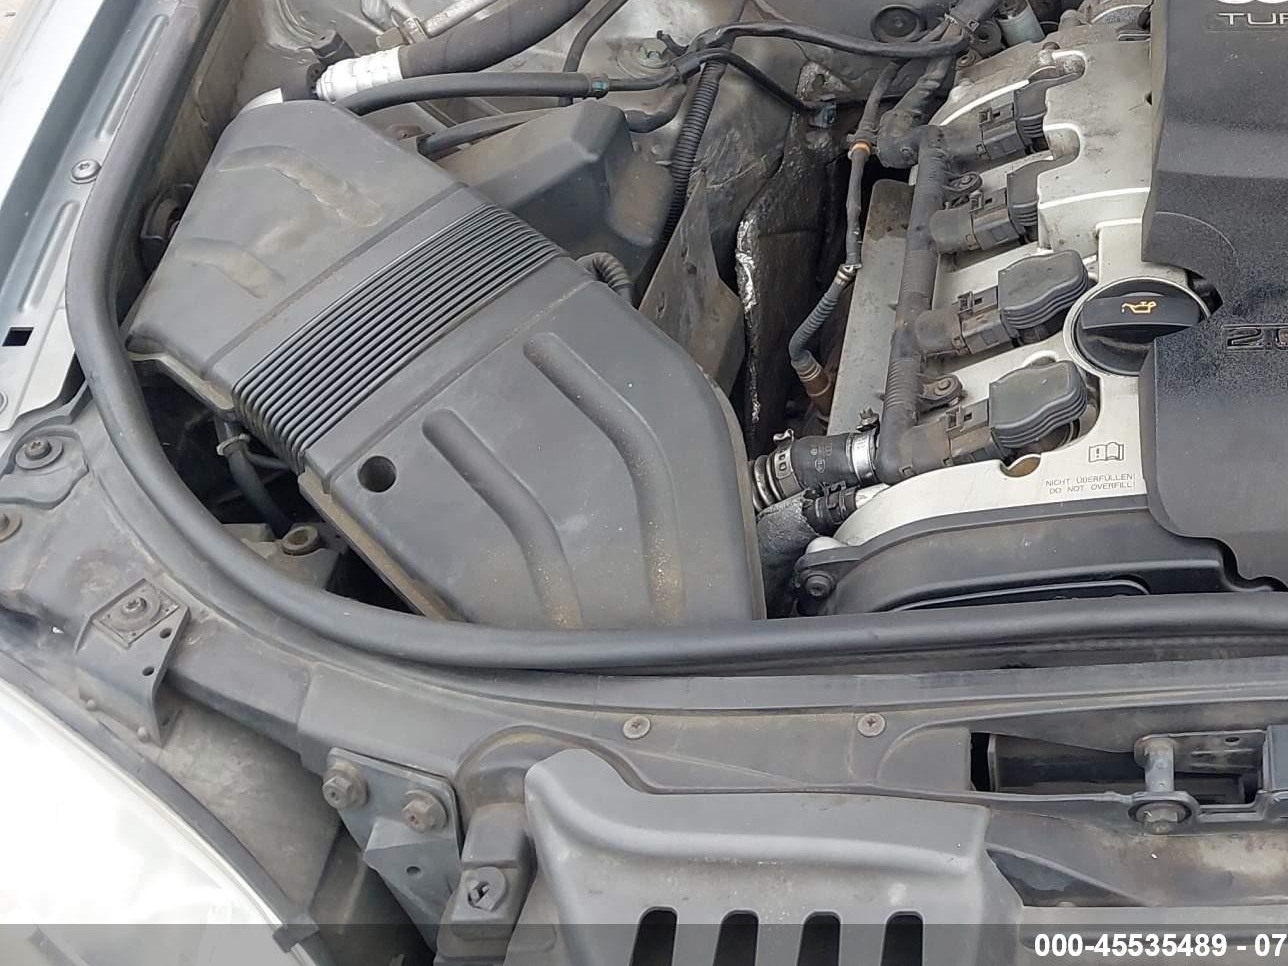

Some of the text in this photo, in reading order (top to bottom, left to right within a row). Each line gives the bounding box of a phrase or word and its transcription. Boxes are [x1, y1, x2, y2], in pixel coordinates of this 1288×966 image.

[1045, 478, 1071, 487] NICHT
[1049, 487, 1062, 495] DO
[1067, 485, 1085, 493] NOT
